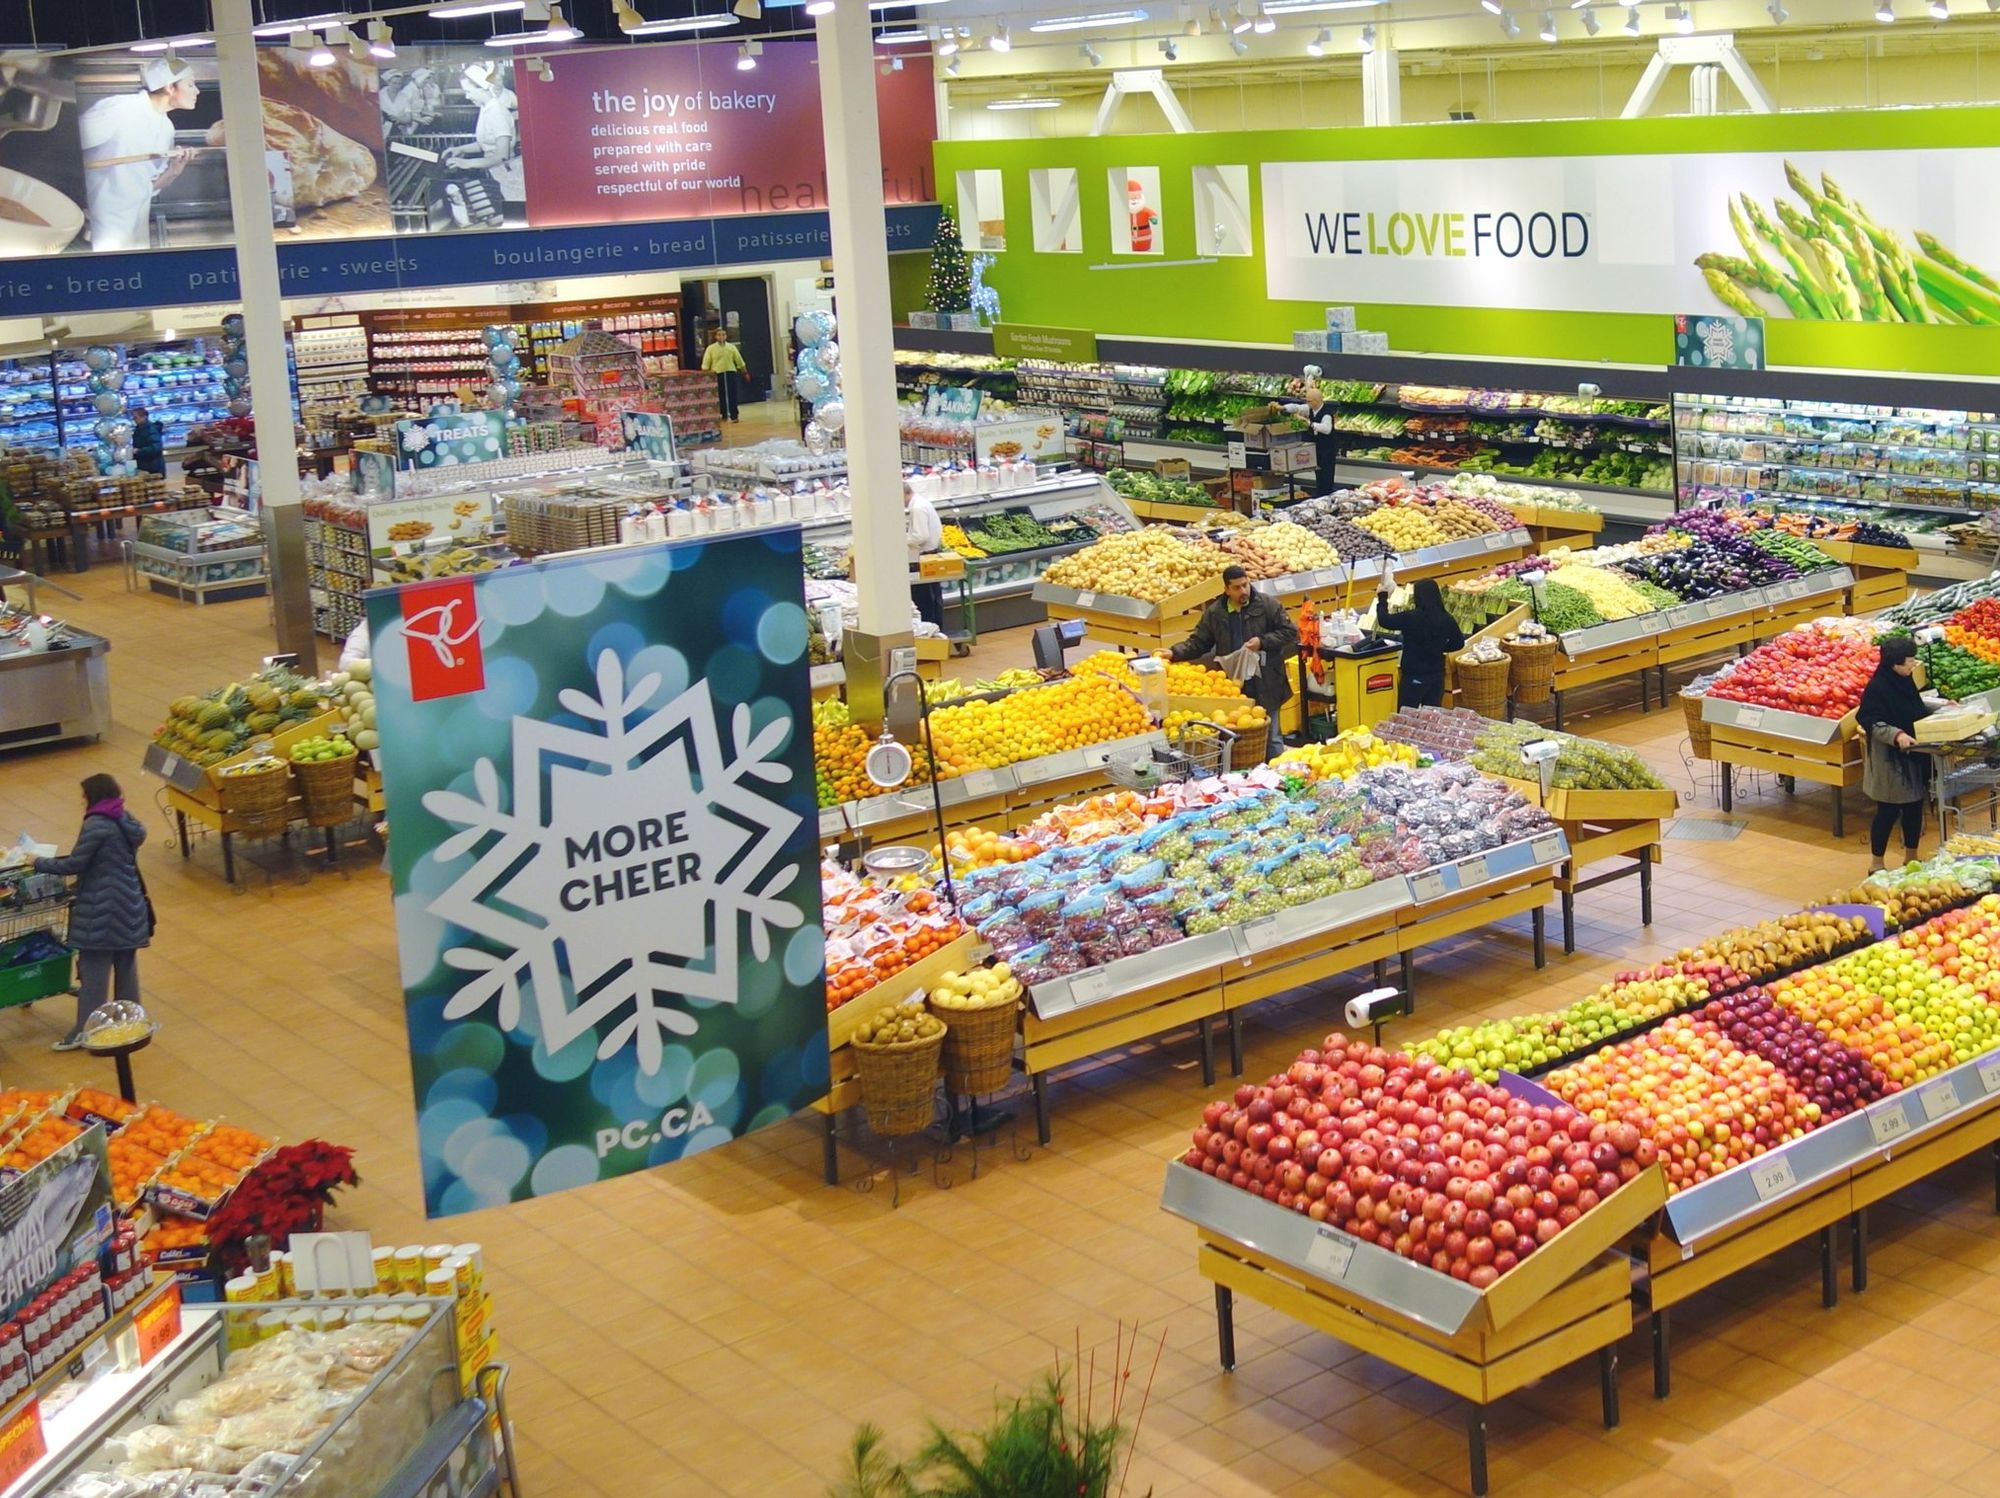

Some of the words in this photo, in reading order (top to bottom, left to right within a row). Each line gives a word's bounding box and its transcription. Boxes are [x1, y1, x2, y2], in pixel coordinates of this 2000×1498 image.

[592, 89, 636, 113] the
[642, 88, 680, 118] joy
[684, 91, 703, 111] of
[709, 90, 776, 113] bakery
[591, 124, 650, 136] delicious
[653, 122, 677, 134] real
[681, 121, 708, 133] food
[593, 142, 651, 159] prepared
[655, 141, 682, 153] with
[685, 142, 712, 152] care
[594, 162, 638, 175] served
[641, 160, 669, 173] with
[672, 159, 706, 174] pride
[597, 180, 662, 196] respectful
[665, 178, 678, 190] of
[681, 179, 703, 190] our
[705, 176, 741, 188] world
[737, 230, 830, 251] patisserie
[1304, 212, 1362, 255] WE
[1367, 212, 1466, 257] LOVE
[1473, 211, 1589, 258] FOOD
[494, 243, 623, 265] boulangerie
[649, 235, 705, 255] bread
[339, 258, 418, 276] sweets
[66, 272, 143, 294] bread
[435, 425, 489, 441] TREATS
[565, 810, 689, 869] MORE
[560, 852, 702, 912] CHEER
[596, 1100, 715, 1159] PC.CA
[1882, 1117, 1899, 1132] 2.99
[1766, 1171, 1784, 1188] 2.99
